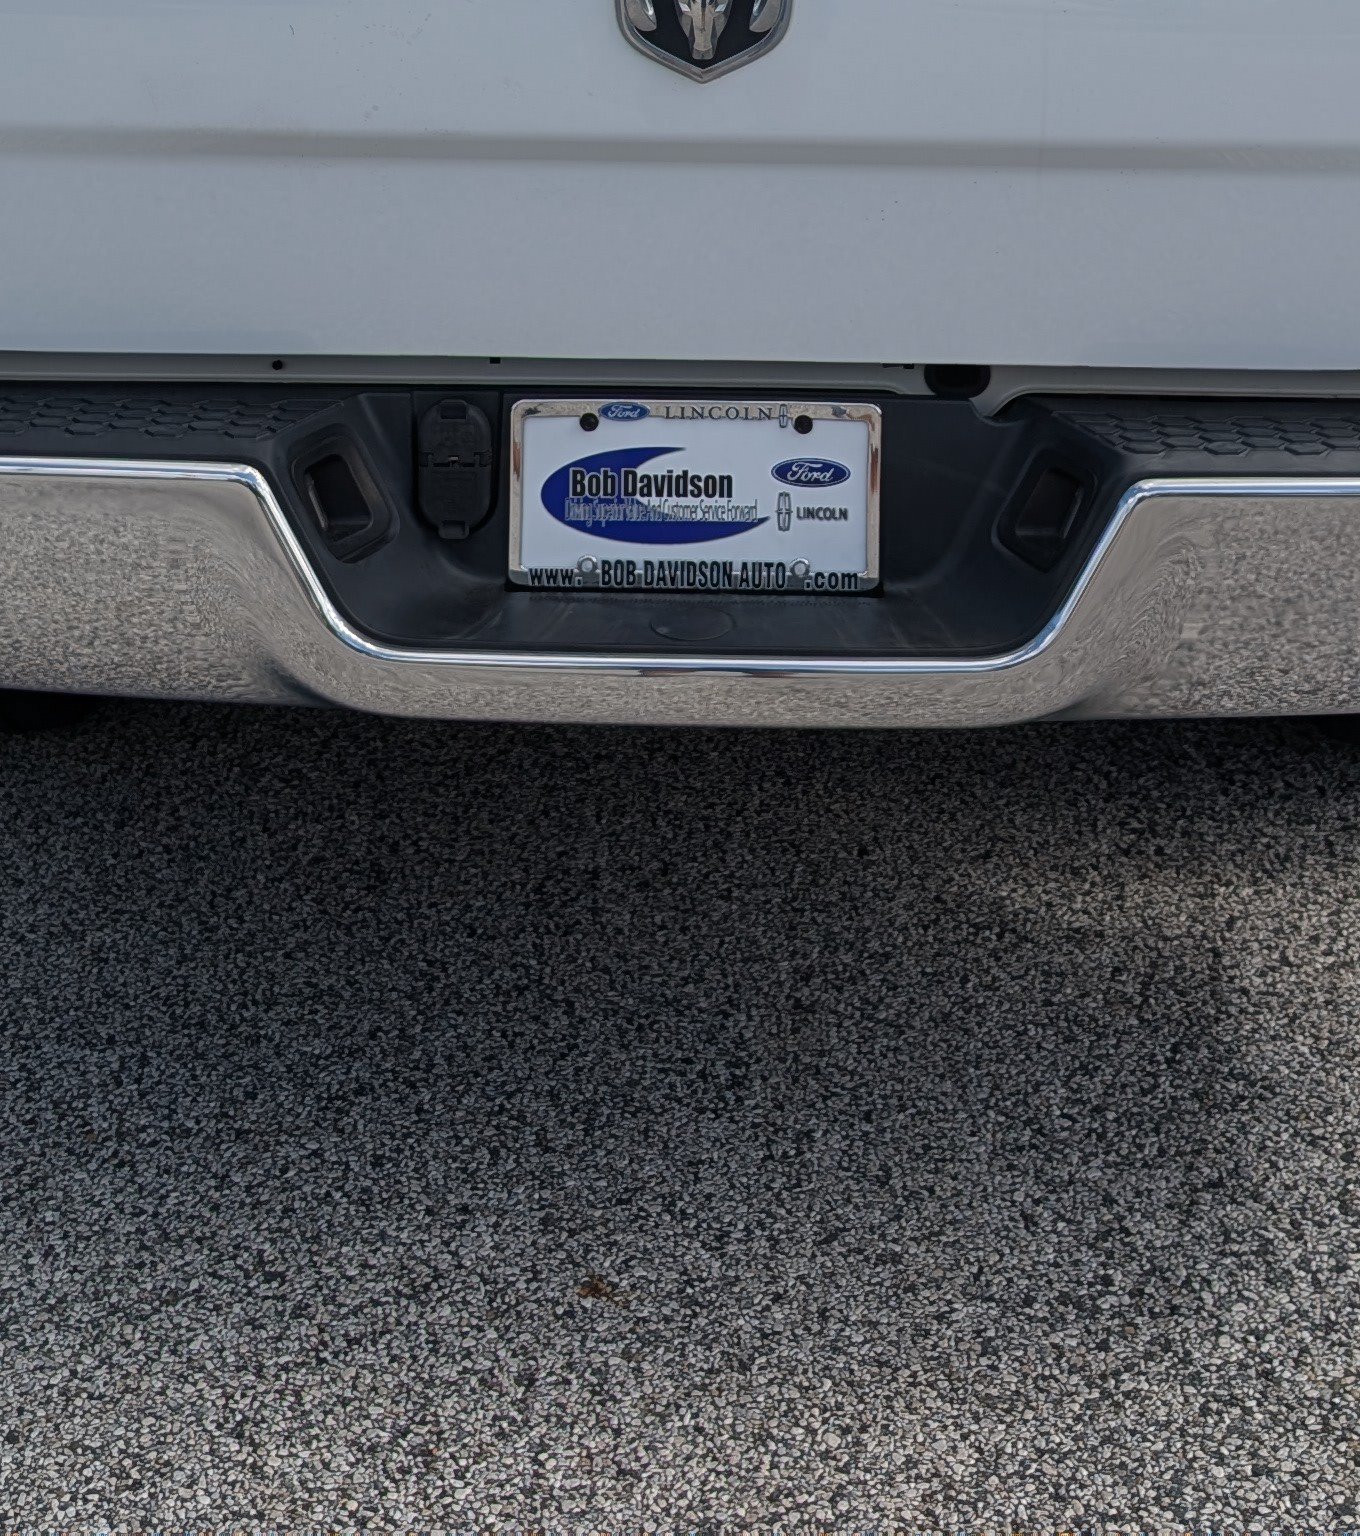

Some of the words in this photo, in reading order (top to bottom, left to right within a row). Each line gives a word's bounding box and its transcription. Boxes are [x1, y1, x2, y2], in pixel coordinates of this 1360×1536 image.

[607, 405, 640, 420] Ford
[664, 405, 773, 421] LINCOLN
[786, 461, 834, 482] Ford
[571, 468, 617, 498] Bob
[624, 468, 733, 499] Davidson
[796, 506, 849, 521] LINCOLN
[528, 568, 582, 586] www.
[600, 559, 636, 586] BOB
[644, 560, 733, 588] DAVIDSON
[740, 561, 786, 589] AUTO
[805, 571, 858, 590] .com
